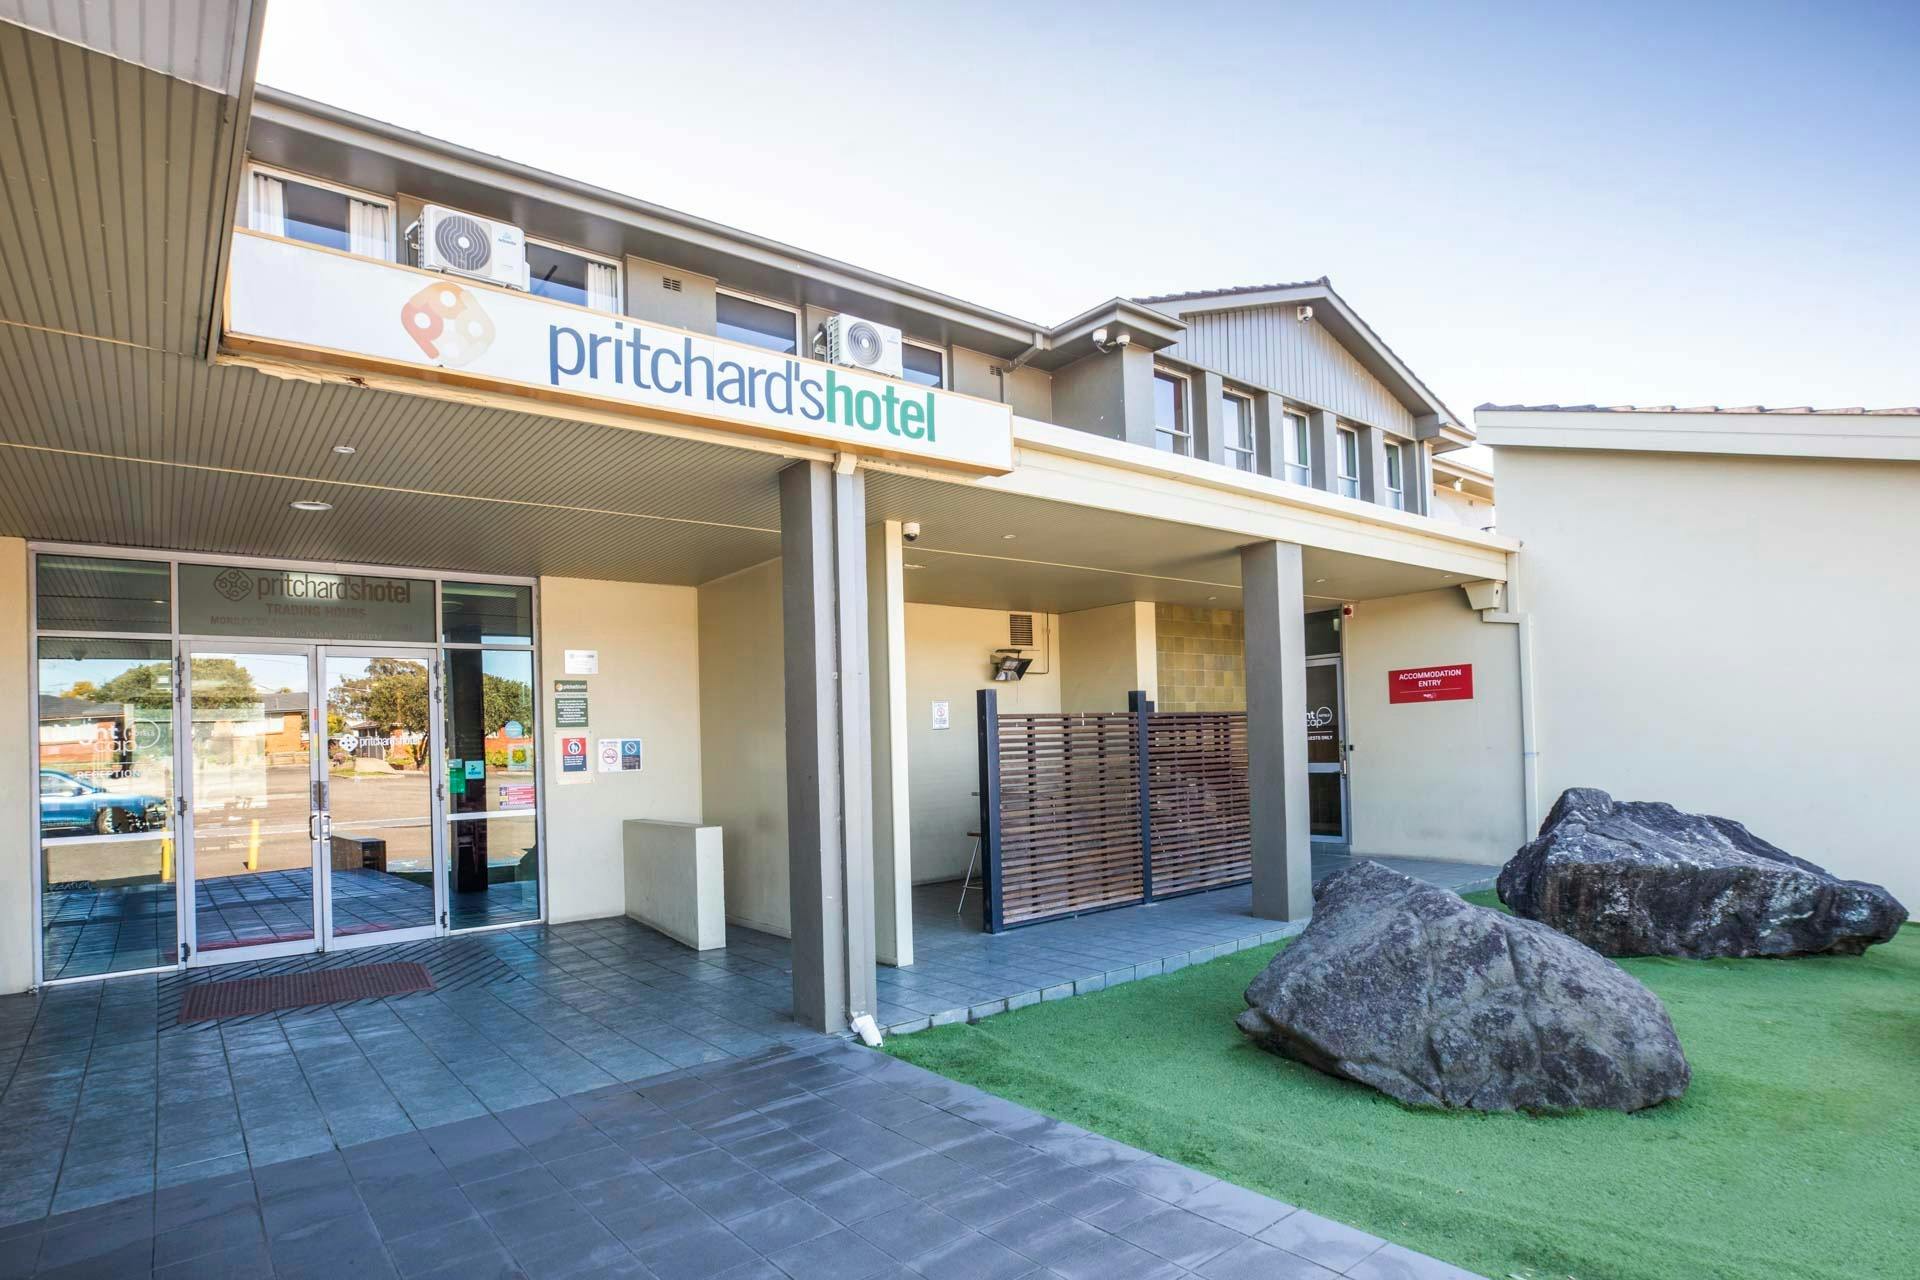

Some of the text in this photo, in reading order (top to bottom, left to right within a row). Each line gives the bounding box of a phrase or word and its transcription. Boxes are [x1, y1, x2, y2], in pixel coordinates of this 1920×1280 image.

[266, 603, 368, 618] TRADING HOURS
[1399, 669, 1461, 680] ACCOMMODATION
[95, 740, 137, 756] cap
[77, 769, 140, 779] RECEPTION
